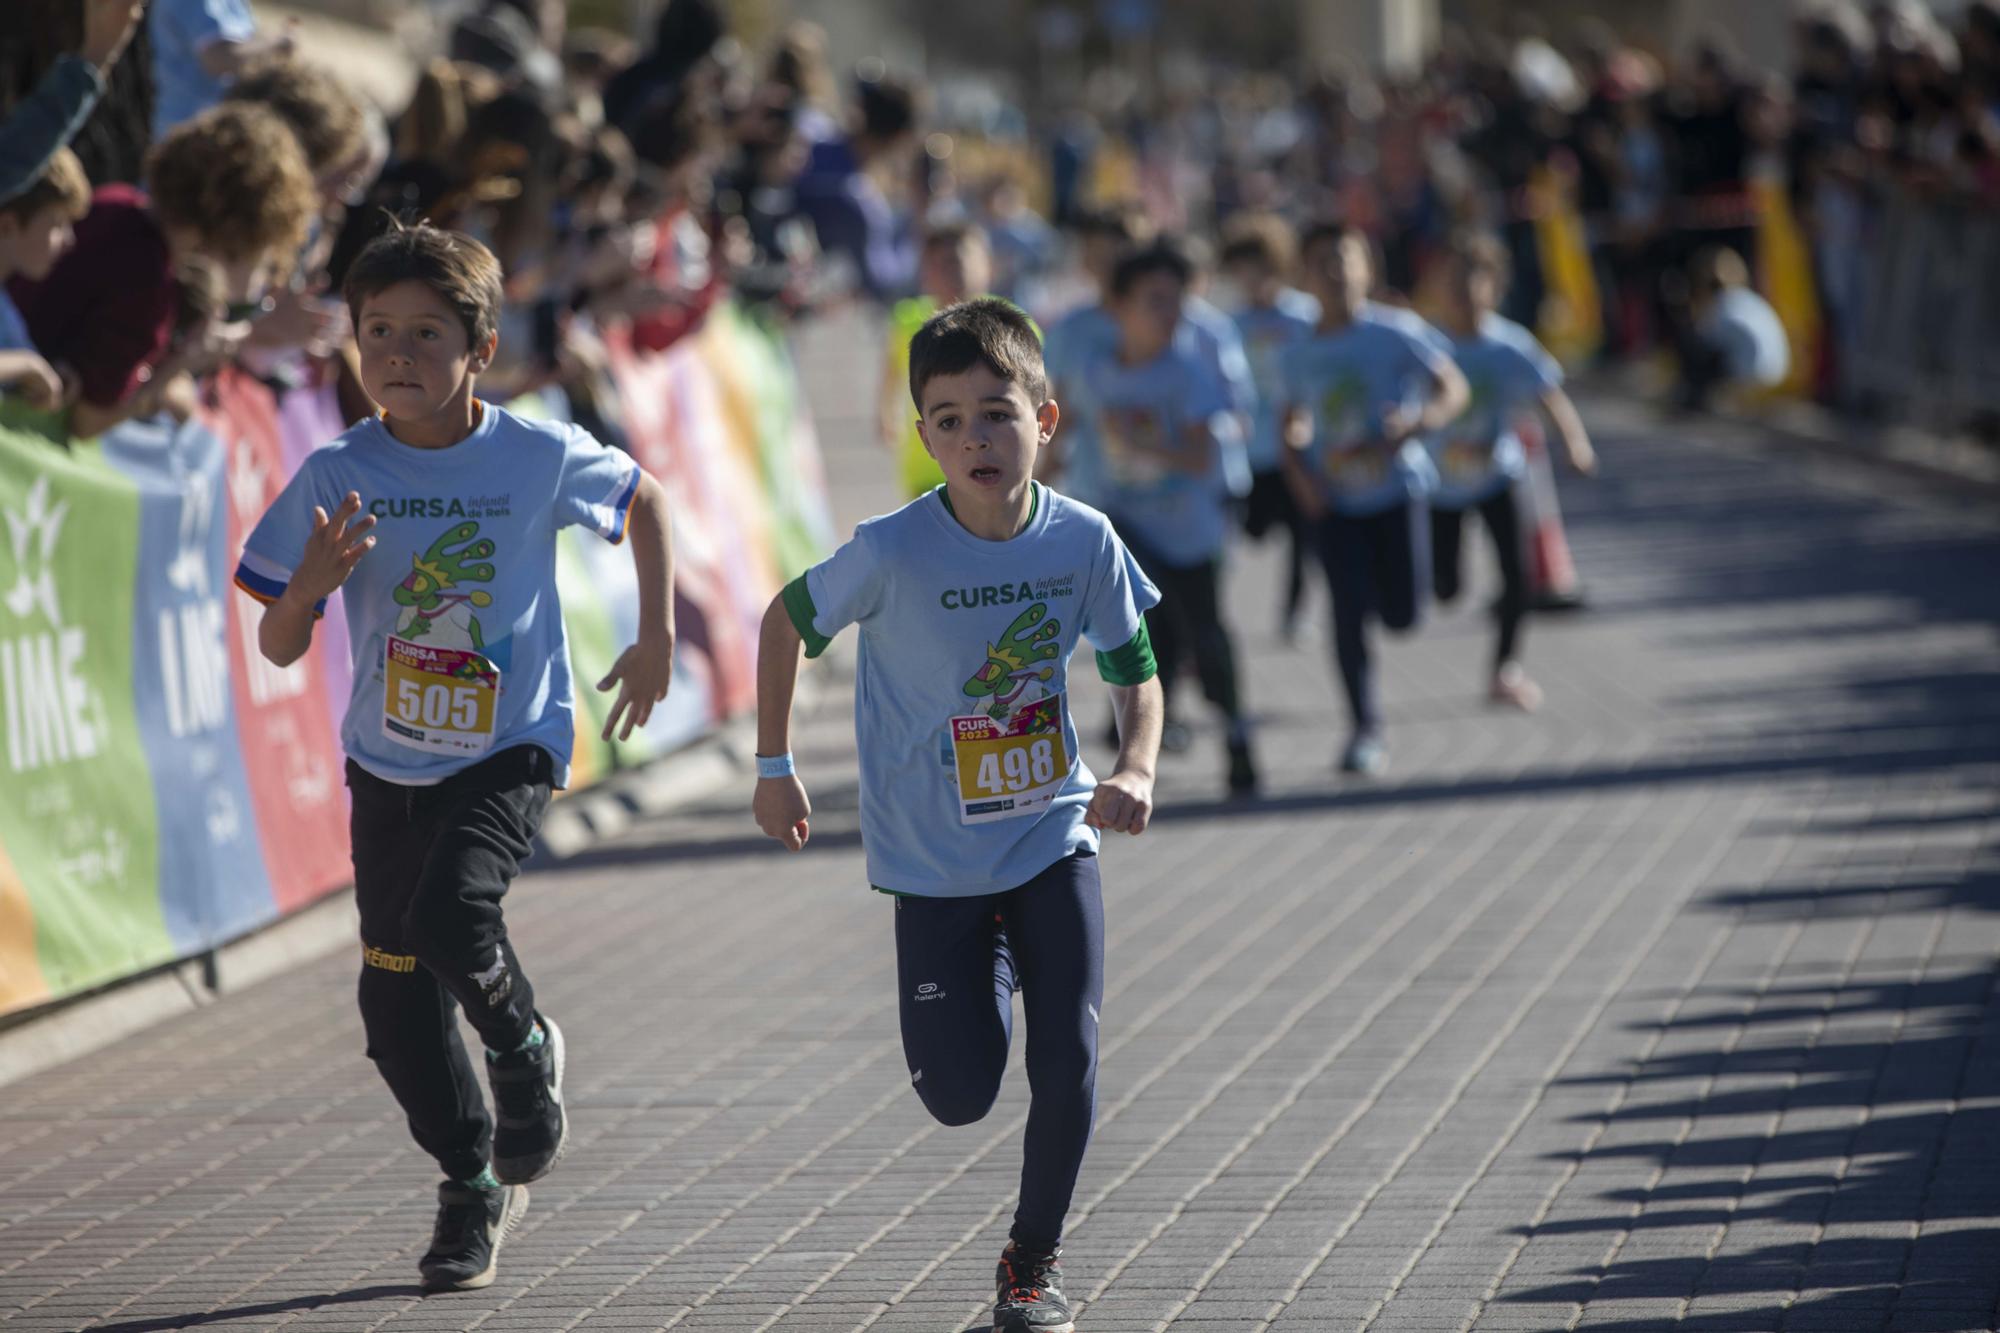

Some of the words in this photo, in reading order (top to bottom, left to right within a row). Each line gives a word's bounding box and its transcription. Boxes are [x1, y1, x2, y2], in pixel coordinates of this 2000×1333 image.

[369, 498, 466, 518] CURSA
[1036, 573, 1074, 590] infantil
[941, 581, 1034, 610] CURSA
[1036, 589, 1048, 600] de
[1051, 587, 1073, 598] Reis
[392, 641, 437, 661] CURSA
[397, 678, 478, 730] 505
[958, 718, 998, 731] CURS
[960, 729, 990, 740] 2023
[977, 738, 1054, 795] 498
